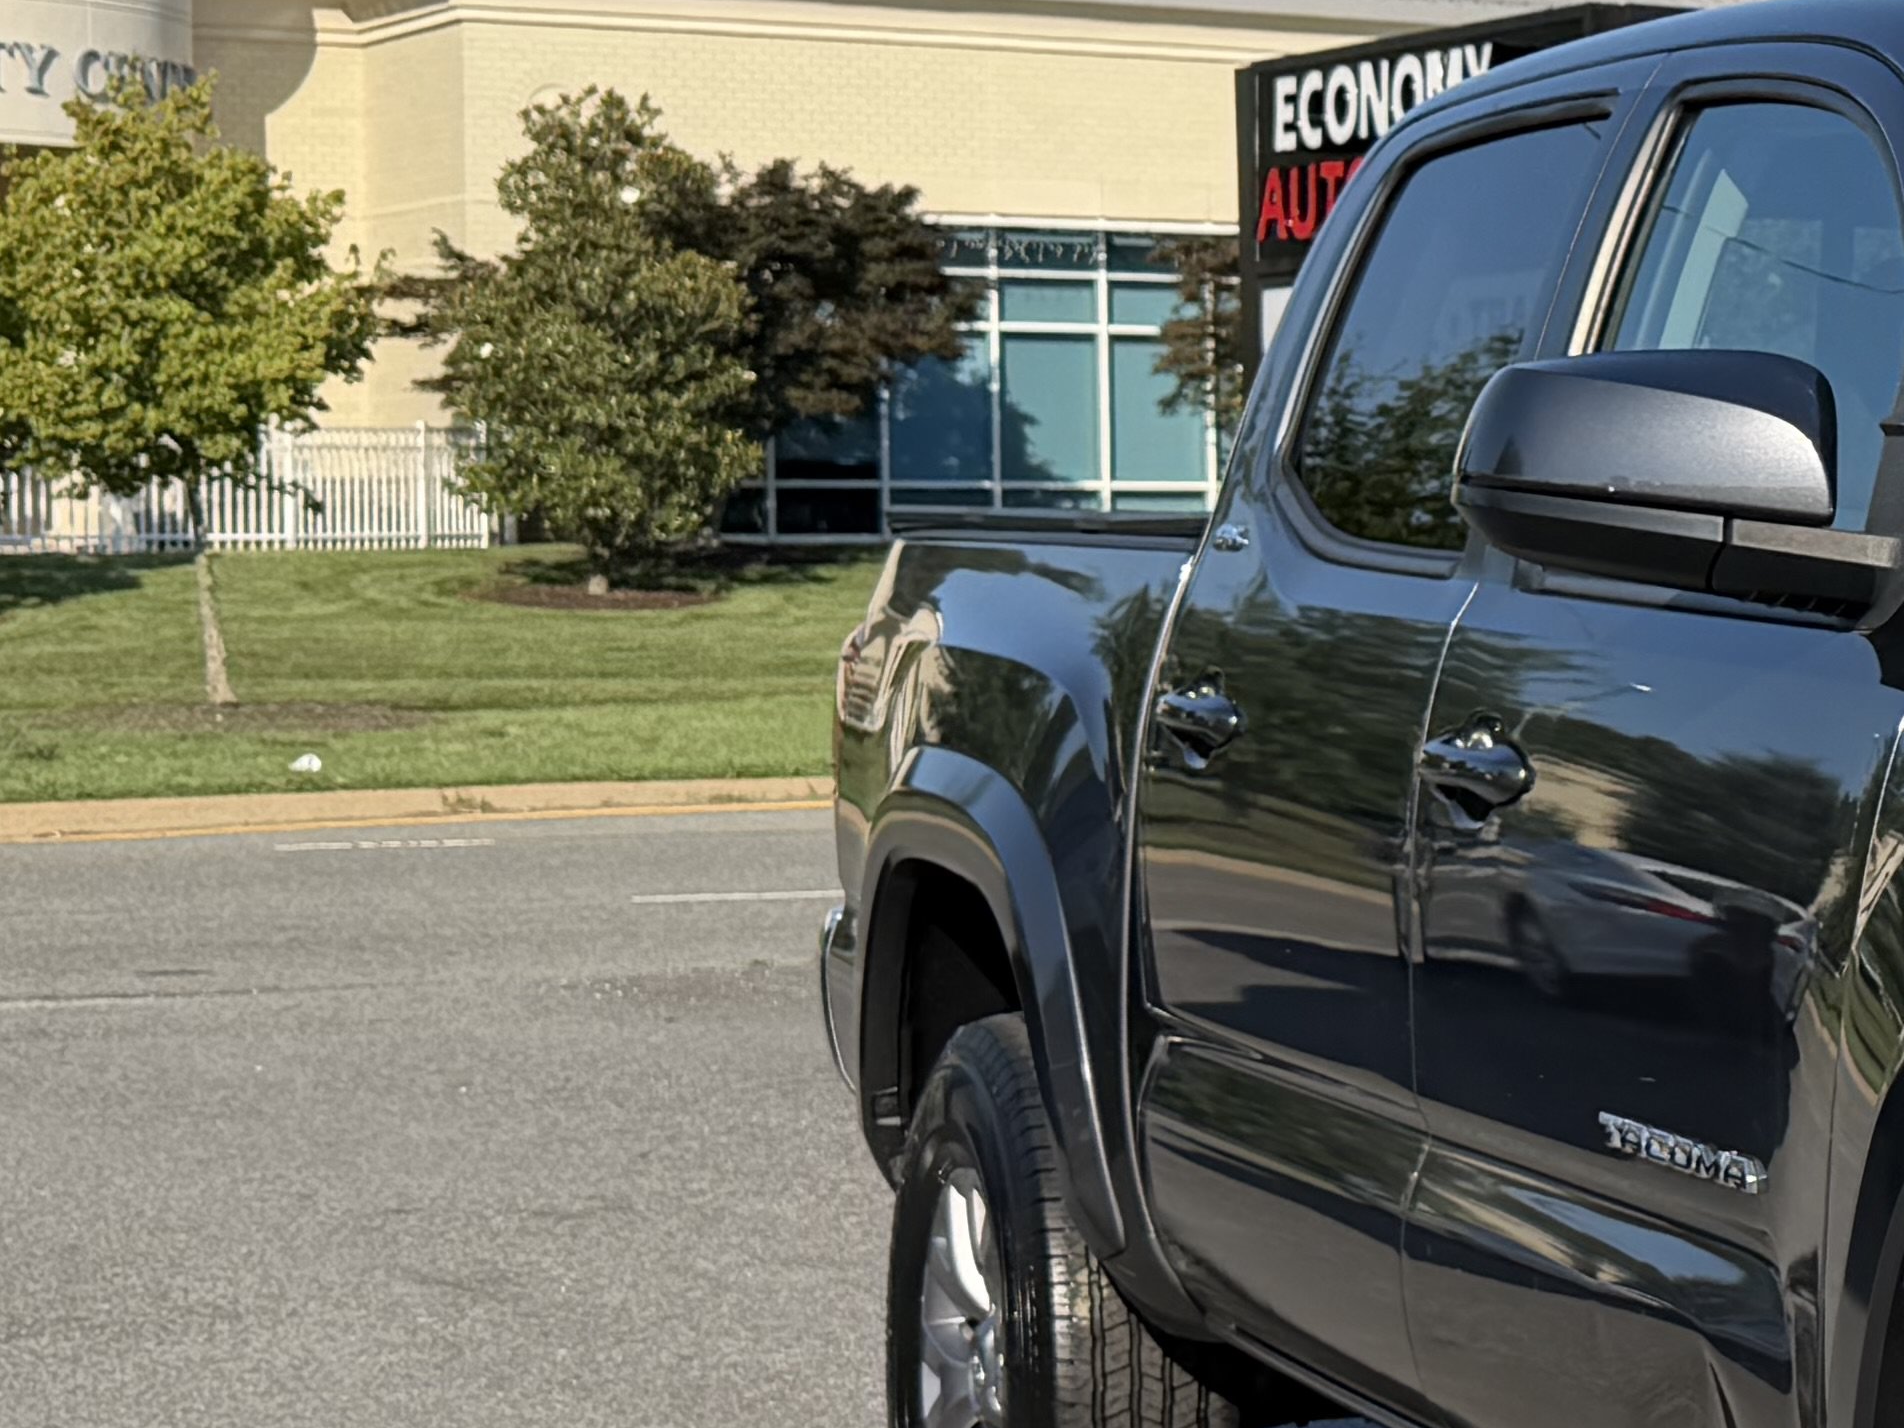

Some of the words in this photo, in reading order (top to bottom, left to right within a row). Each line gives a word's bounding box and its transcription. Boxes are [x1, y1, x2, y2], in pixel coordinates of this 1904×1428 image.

[1273, 42, 1493, 153] ECONOMY
[1256, 156, 1365, 242] AUT
[1598, 1110, 1768, 1195] TACOMA
